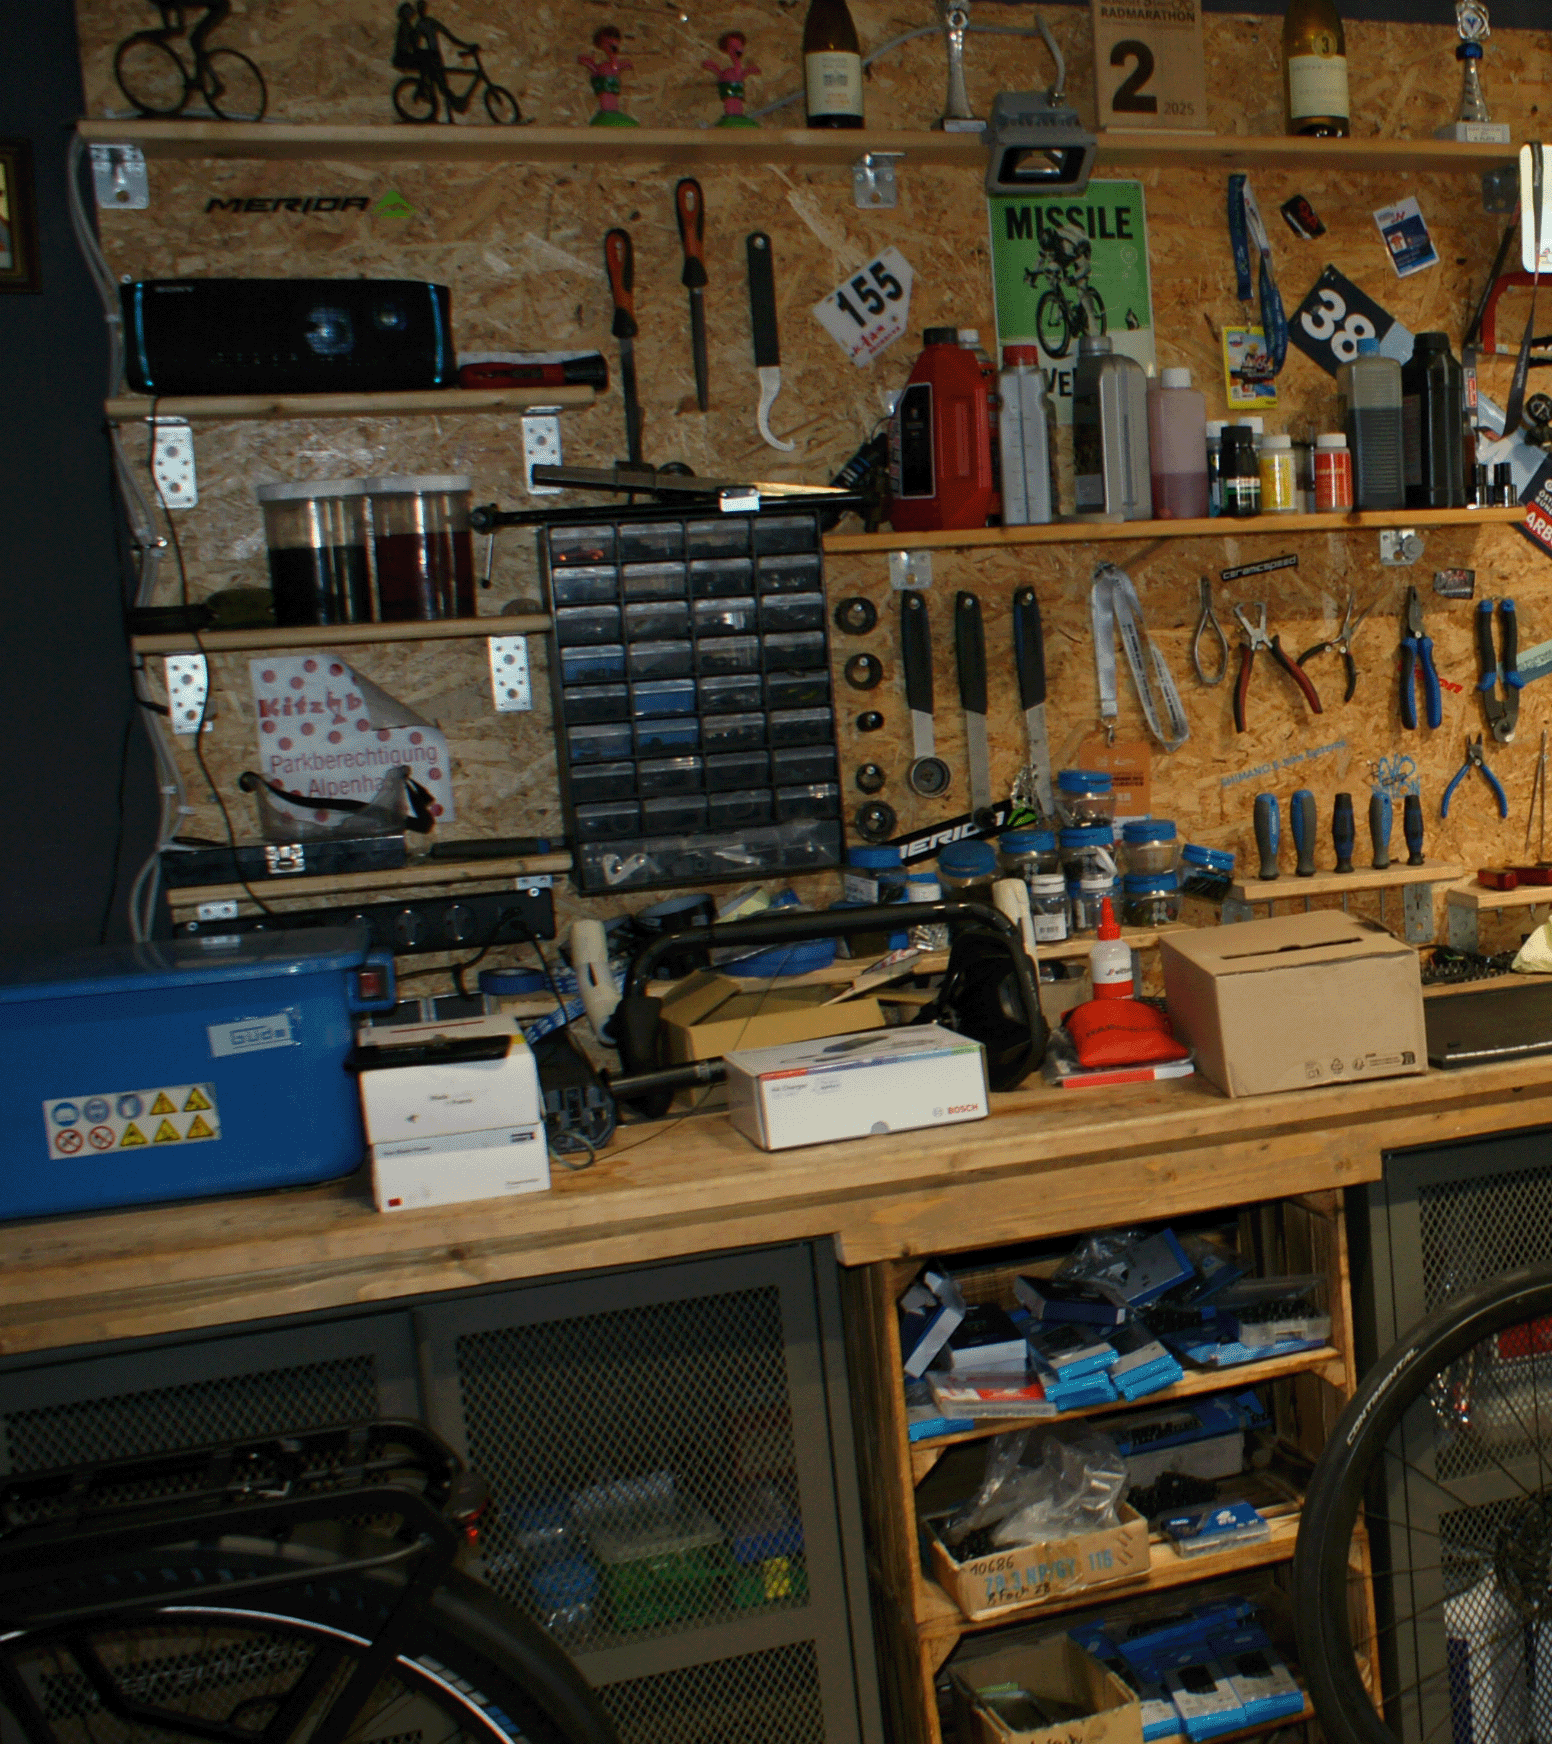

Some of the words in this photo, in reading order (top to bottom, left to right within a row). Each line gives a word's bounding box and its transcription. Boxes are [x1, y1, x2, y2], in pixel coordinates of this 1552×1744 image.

[1101, 7, 1196, 22] RADMARATHON
[1110, 40, 1158, 114] 2
[1163, 101, 1195, 116] 2025
[205, 196, 370, 214] MERIDA
[1005, 205, 1134, 241] MISSILE
[836, 261, 904, 328] 155
[1301, 288, 1377, 364] 38
[270, 746, 438, 774] Parkberechtigung
[1221, 764, 1271, 787] SHIMANO
[948, 1103, 978, 1115] BOSCH
[970, 1555, 1015, 1577] 10686
